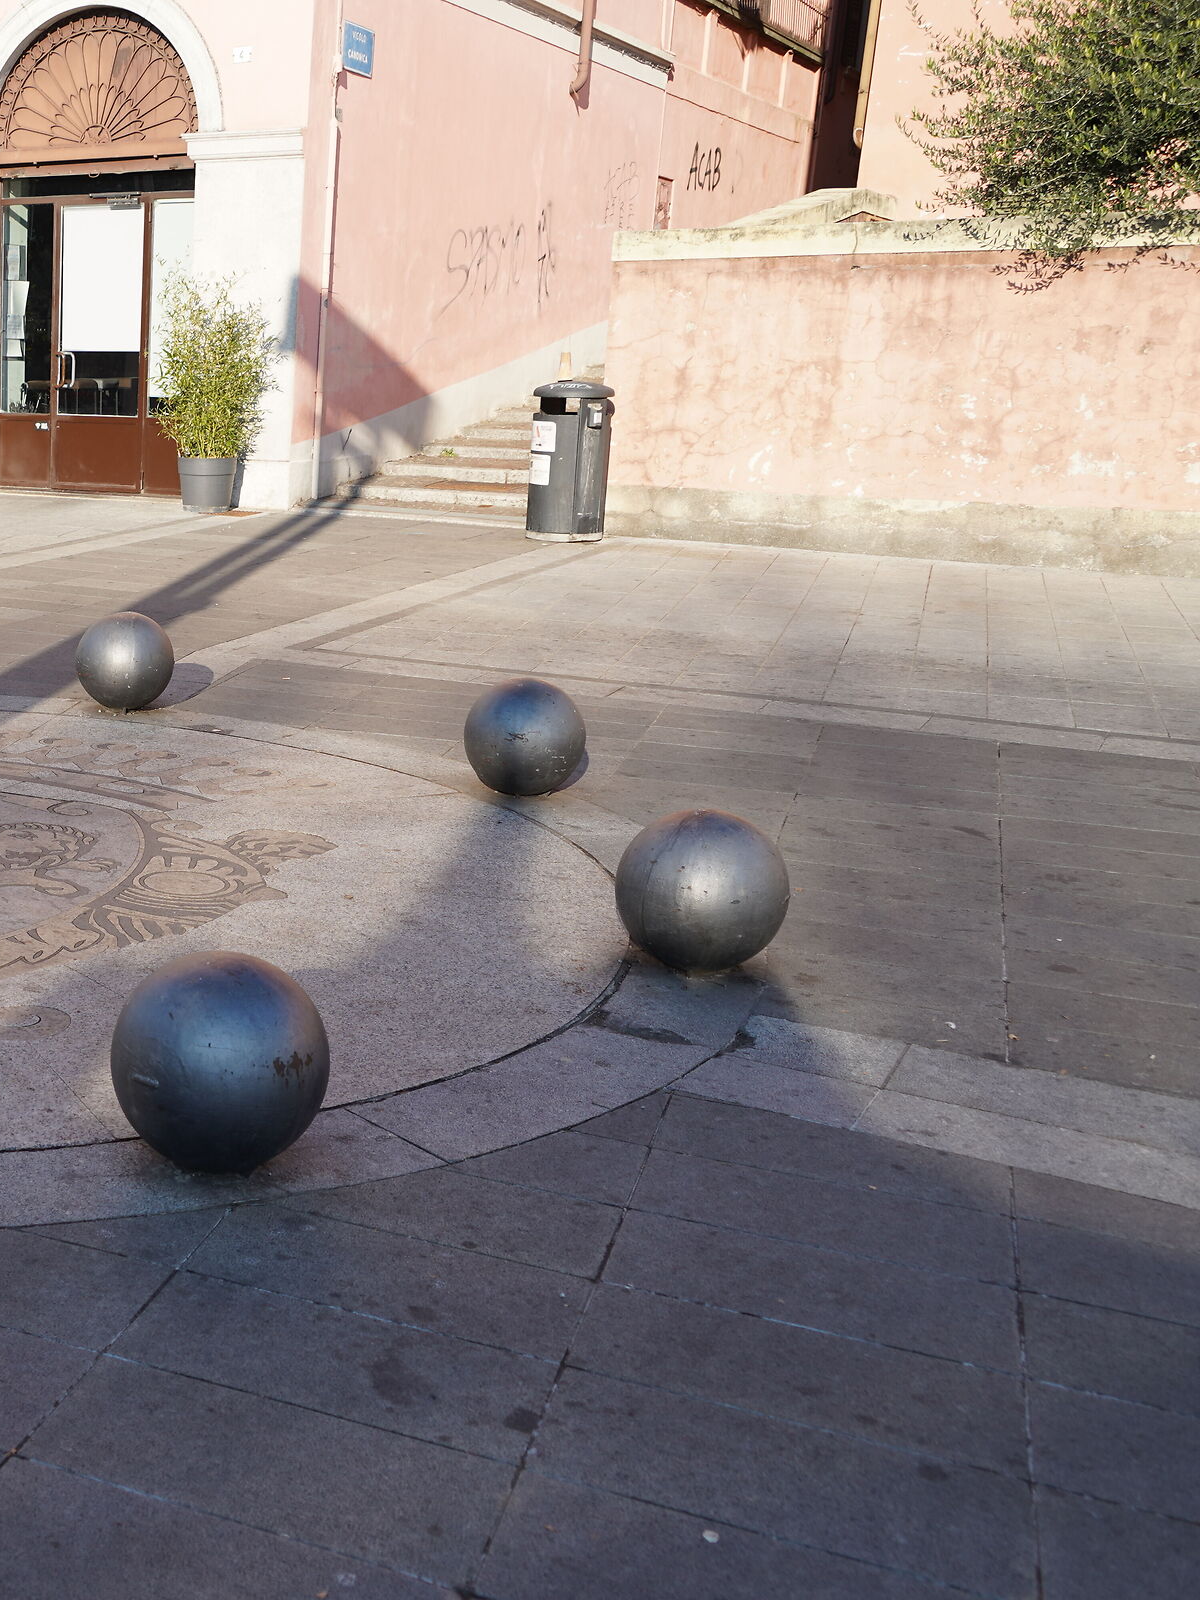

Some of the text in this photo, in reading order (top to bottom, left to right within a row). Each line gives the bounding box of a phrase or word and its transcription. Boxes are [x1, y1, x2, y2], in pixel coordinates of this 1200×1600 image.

[351, 30, 367, 43] VICOLO
[347, 48, 368, 64] CANONICA
[686, 141, 722, 192] ACAB
